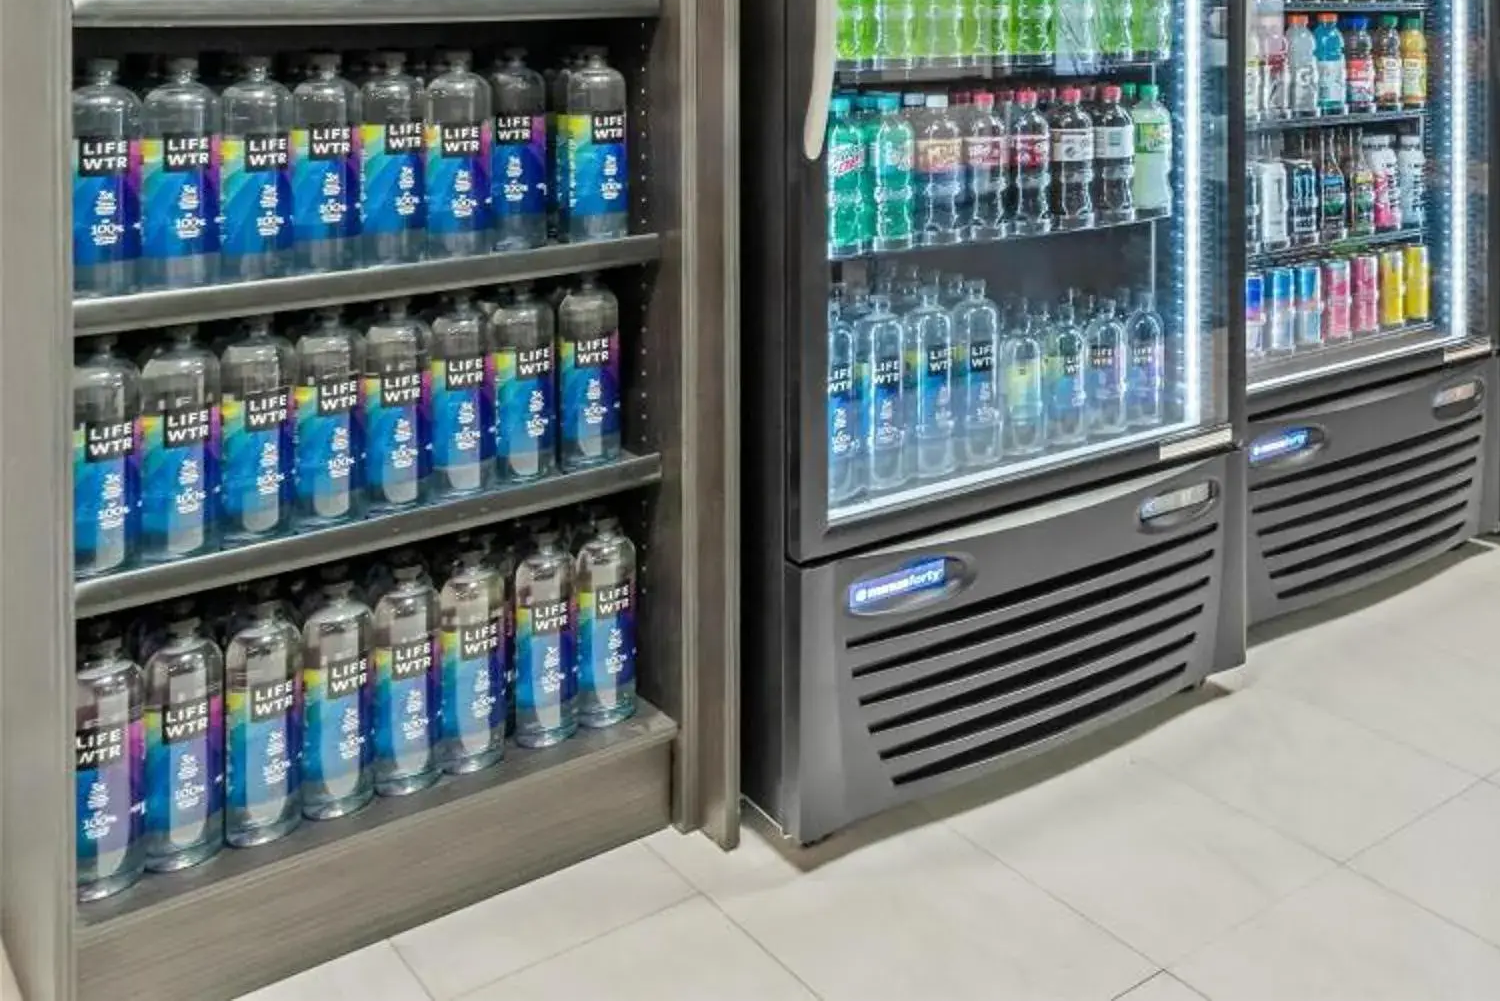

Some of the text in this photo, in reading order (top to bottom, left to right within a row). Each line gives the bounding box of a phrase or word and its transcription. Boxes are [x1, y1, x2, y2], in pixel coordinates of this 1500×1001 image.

[389, 122, 422, 136] LIFE
[498, 115, 531, 128] LIFE
[594, 115, 625, 127] LIFE
[313, 127, 350, 141] LIFE
[444, 126, 480, 139] LIFE
[498, 128, 531, 141] WTR
[594, 127, 623, 139] WTR
[83, 140, 129, 155] LIFE
[168, 136, 209, 151] LIFE
[249, 138, 287, 152] LIFE
[312, 141, 351, 155] WTR
[388, 135, 422, 149] WTR
[443, 139, 481, 153] WTR
[82, 155, 129, 170] WTR
[167, 151, 209, 166] WTR
[249, 152, 287, 166] WTR
[578, 338, 609, 352] LIFE
[519, 348, 550, 363] LIFE
[577, 350, 609, 364] WTR
[449, 358, 483, 372] LIFE
[519, 361, 550, 375] WTR
[384, 373, 421, 390] LIFE
[449, 372, 483, 385] WTR
[321, 380, 357, 396] LIFE
[384, 387, 421, 403] WTR
[250, 394, 287, 411] LIFE
[321, 394, 357, 411] WTR
[168, 410, 209, 427] LIFE
[249, 408, 287, 426] WTR
[90, 421, 133, 441] LIFE
[167, 424, 209, 443] WTR
[89, 436, 133, 456] WTR
[599, 585, 629, 601] LIFE
[535, 602, 567, 618] LIFE
[599, 599, 629, 614] WTR
[535, 615, 568, 631] WTR
[464, 624, 497, 641] LIFE
[395, 642, 431, 660] LIFE
[464, 637, 497, 654] WTR
[332, 658, 367, 678] LIFE
[395, 656, 431, 674] WTR
[255, 680, 292, 701] LIFE
[331, 674, 367, 692] WTR
[166, 702, 208, 722] LIFE
[255, 695, 292, 716] WTR
[166, 718, 208, 738] WTR
[76, 727, 122, 748] LIFE
